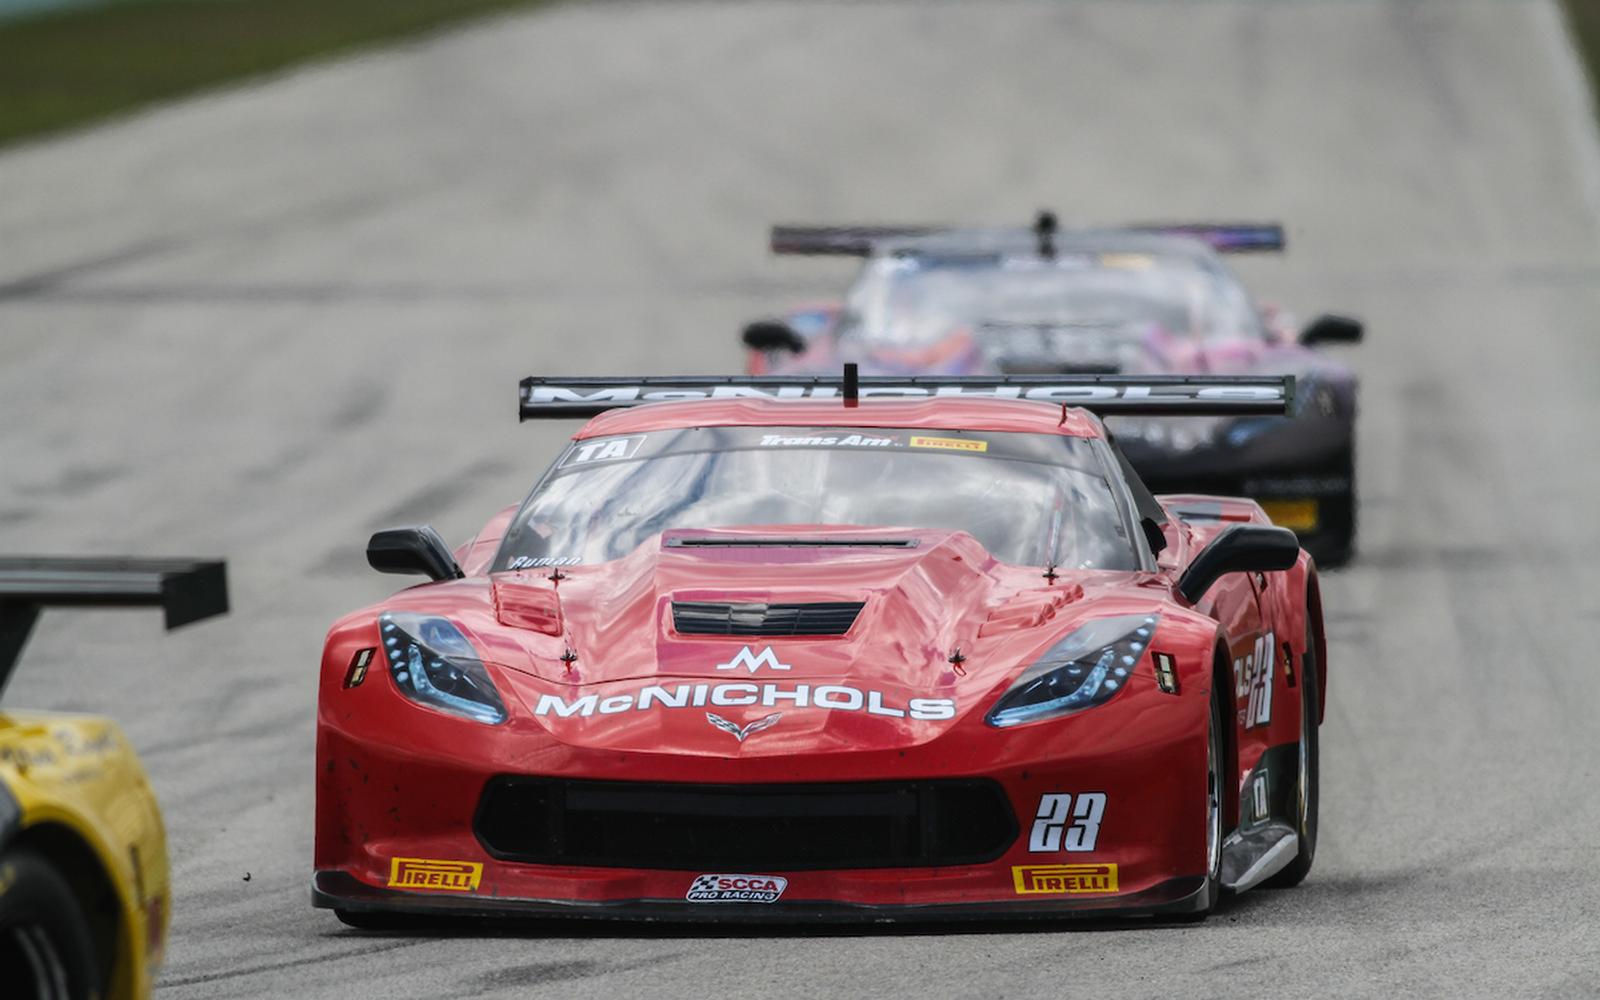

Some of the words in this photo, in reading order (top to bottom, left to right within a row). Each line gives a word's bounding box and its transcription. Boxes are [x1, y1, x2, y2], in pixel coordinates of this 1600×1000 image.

[576, 440, 629, 462] TA
[760, 435, 838, 447] Trans
[838, 435, 892, 447] Am
[534, 683, 956, 721] McNICHOLS
[1028, 792, 1108, 853] 23
[396, 861, 475, 888] PIRELLI
[718, 878, 779, 892] SCCA
[1021, 867, 1110, 891] PIRELLI
[689, 891, 718, 900] PRO
[720, 891, 776, 900] RACING
